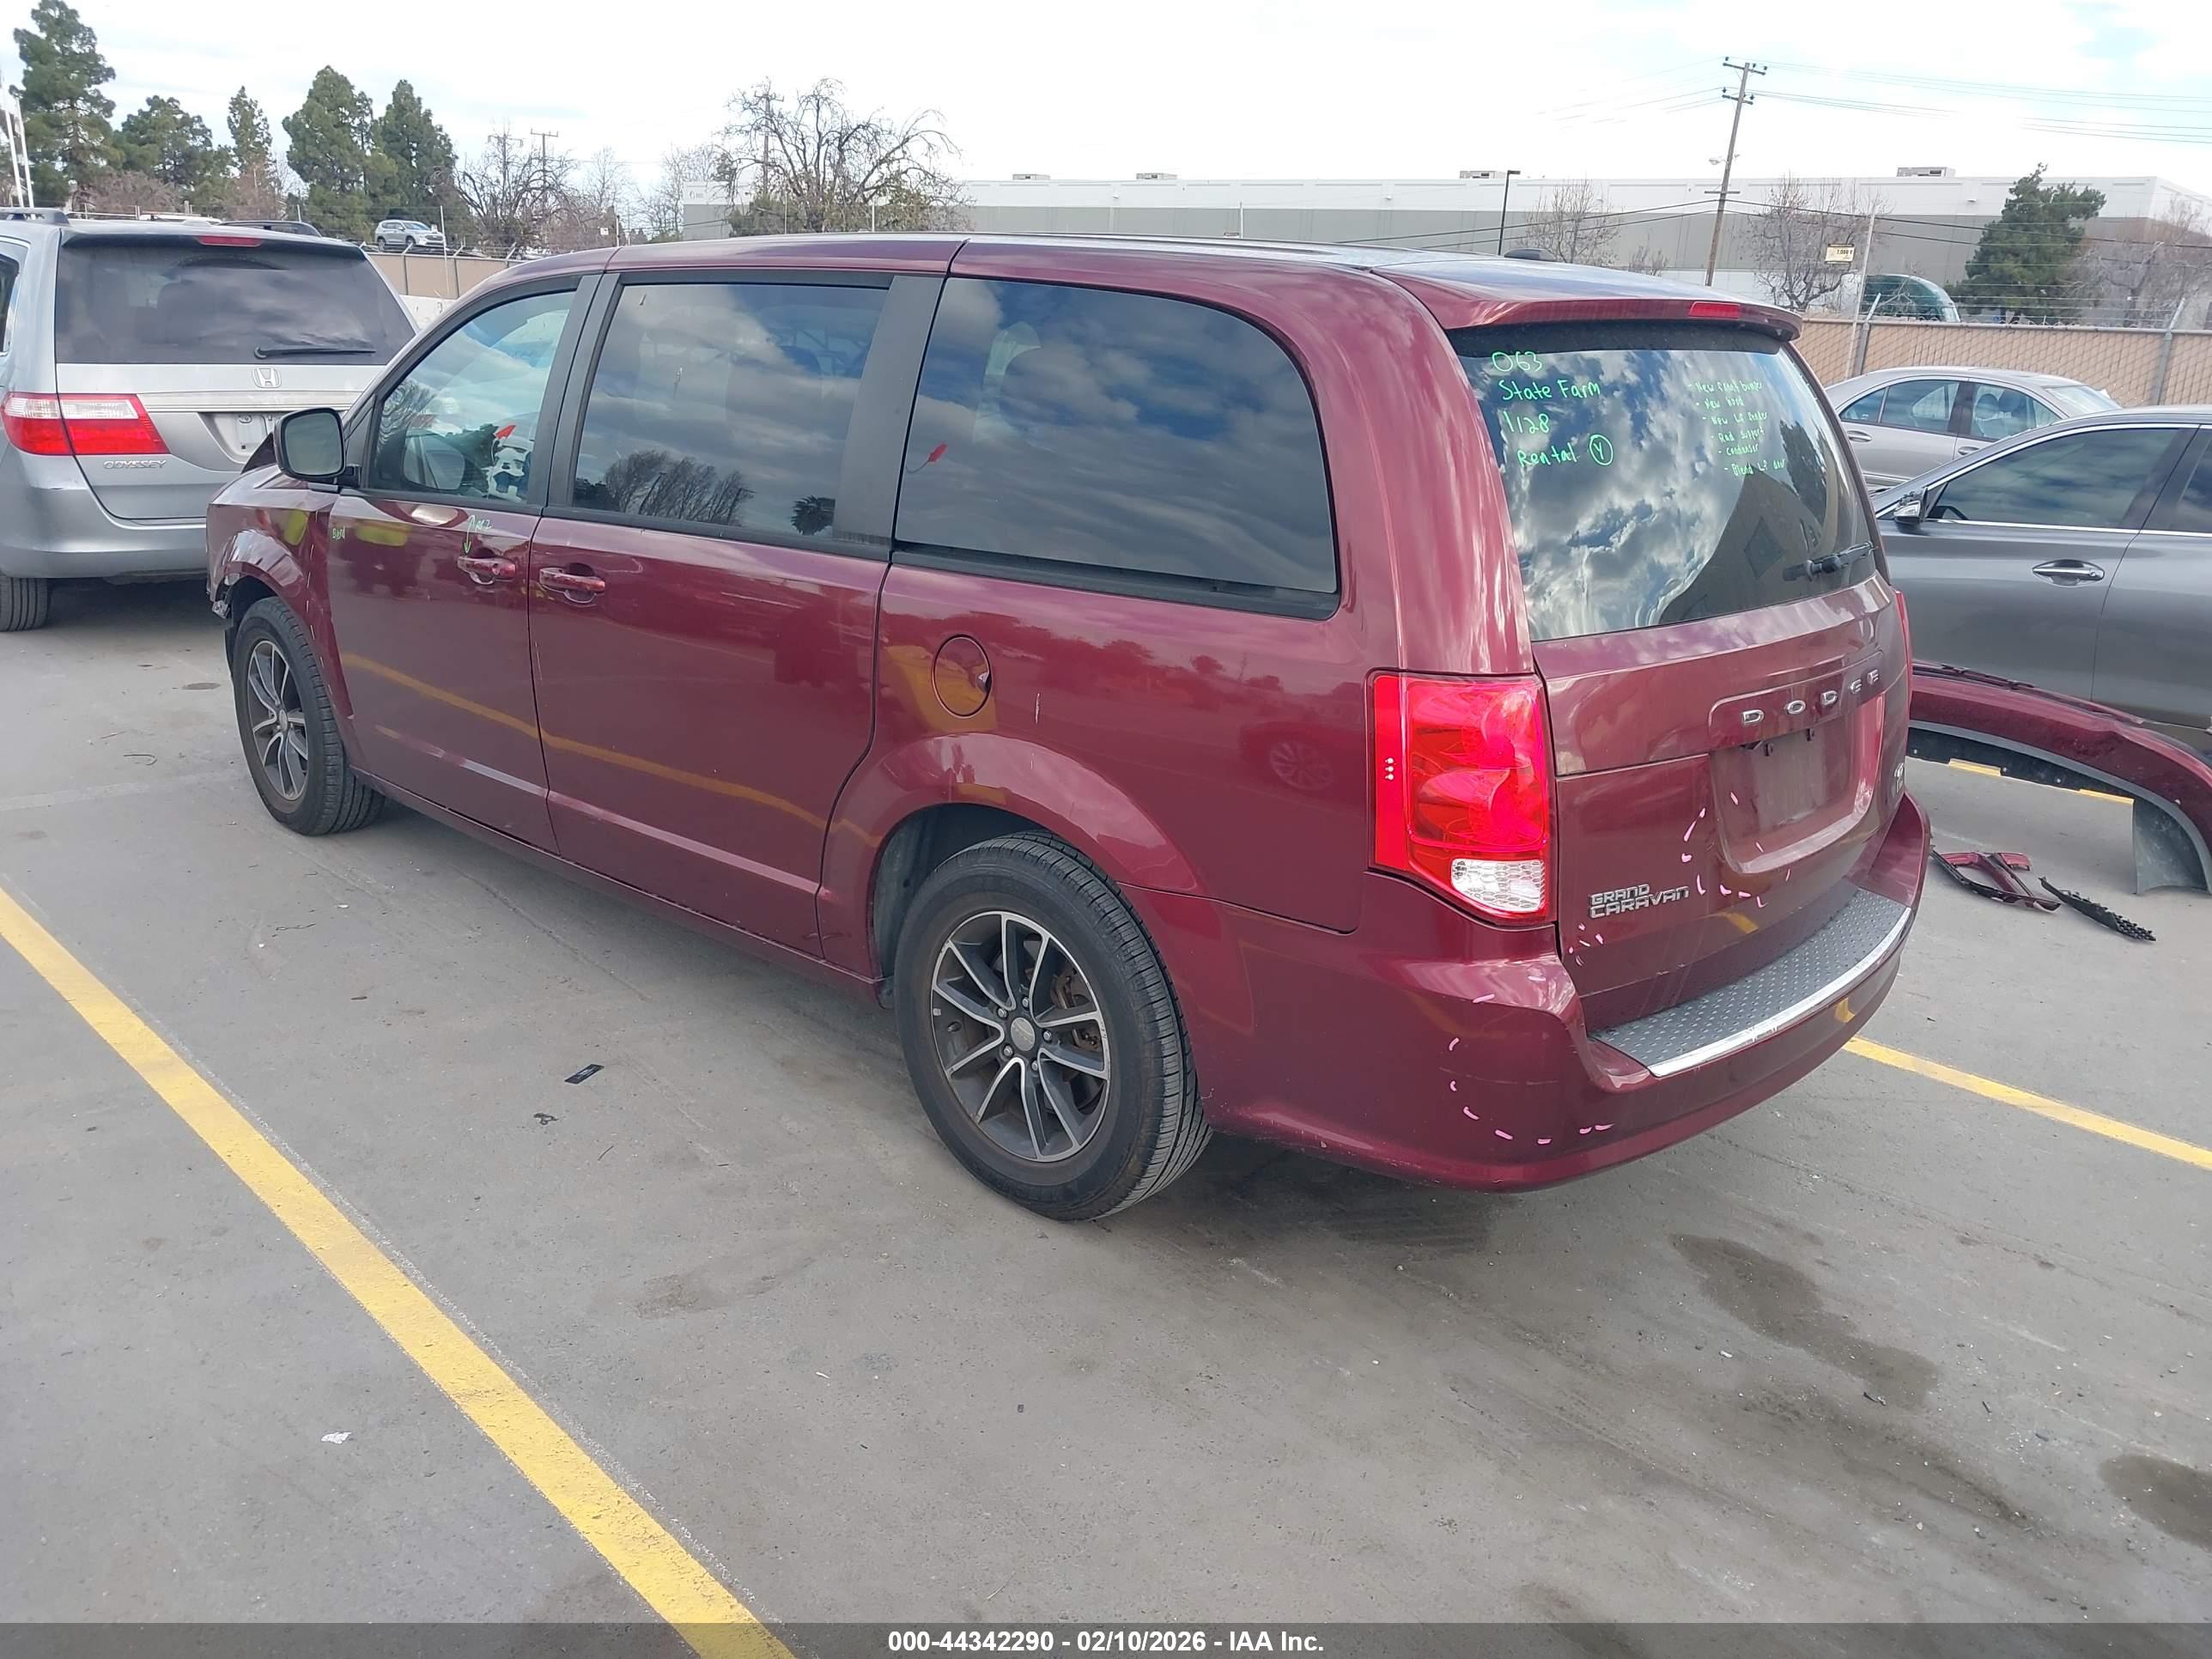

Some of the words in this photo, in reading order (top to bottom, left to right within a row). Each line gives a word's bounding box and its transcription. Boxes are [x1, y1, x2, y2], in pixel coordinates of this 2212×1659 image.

[1498, 379, 1553, 401] State
[1557, 379, 1601, 398] Farm
[103, 459, 167, 470] ODYSSEY
[1741, 669, 1880, 726] DODGE
